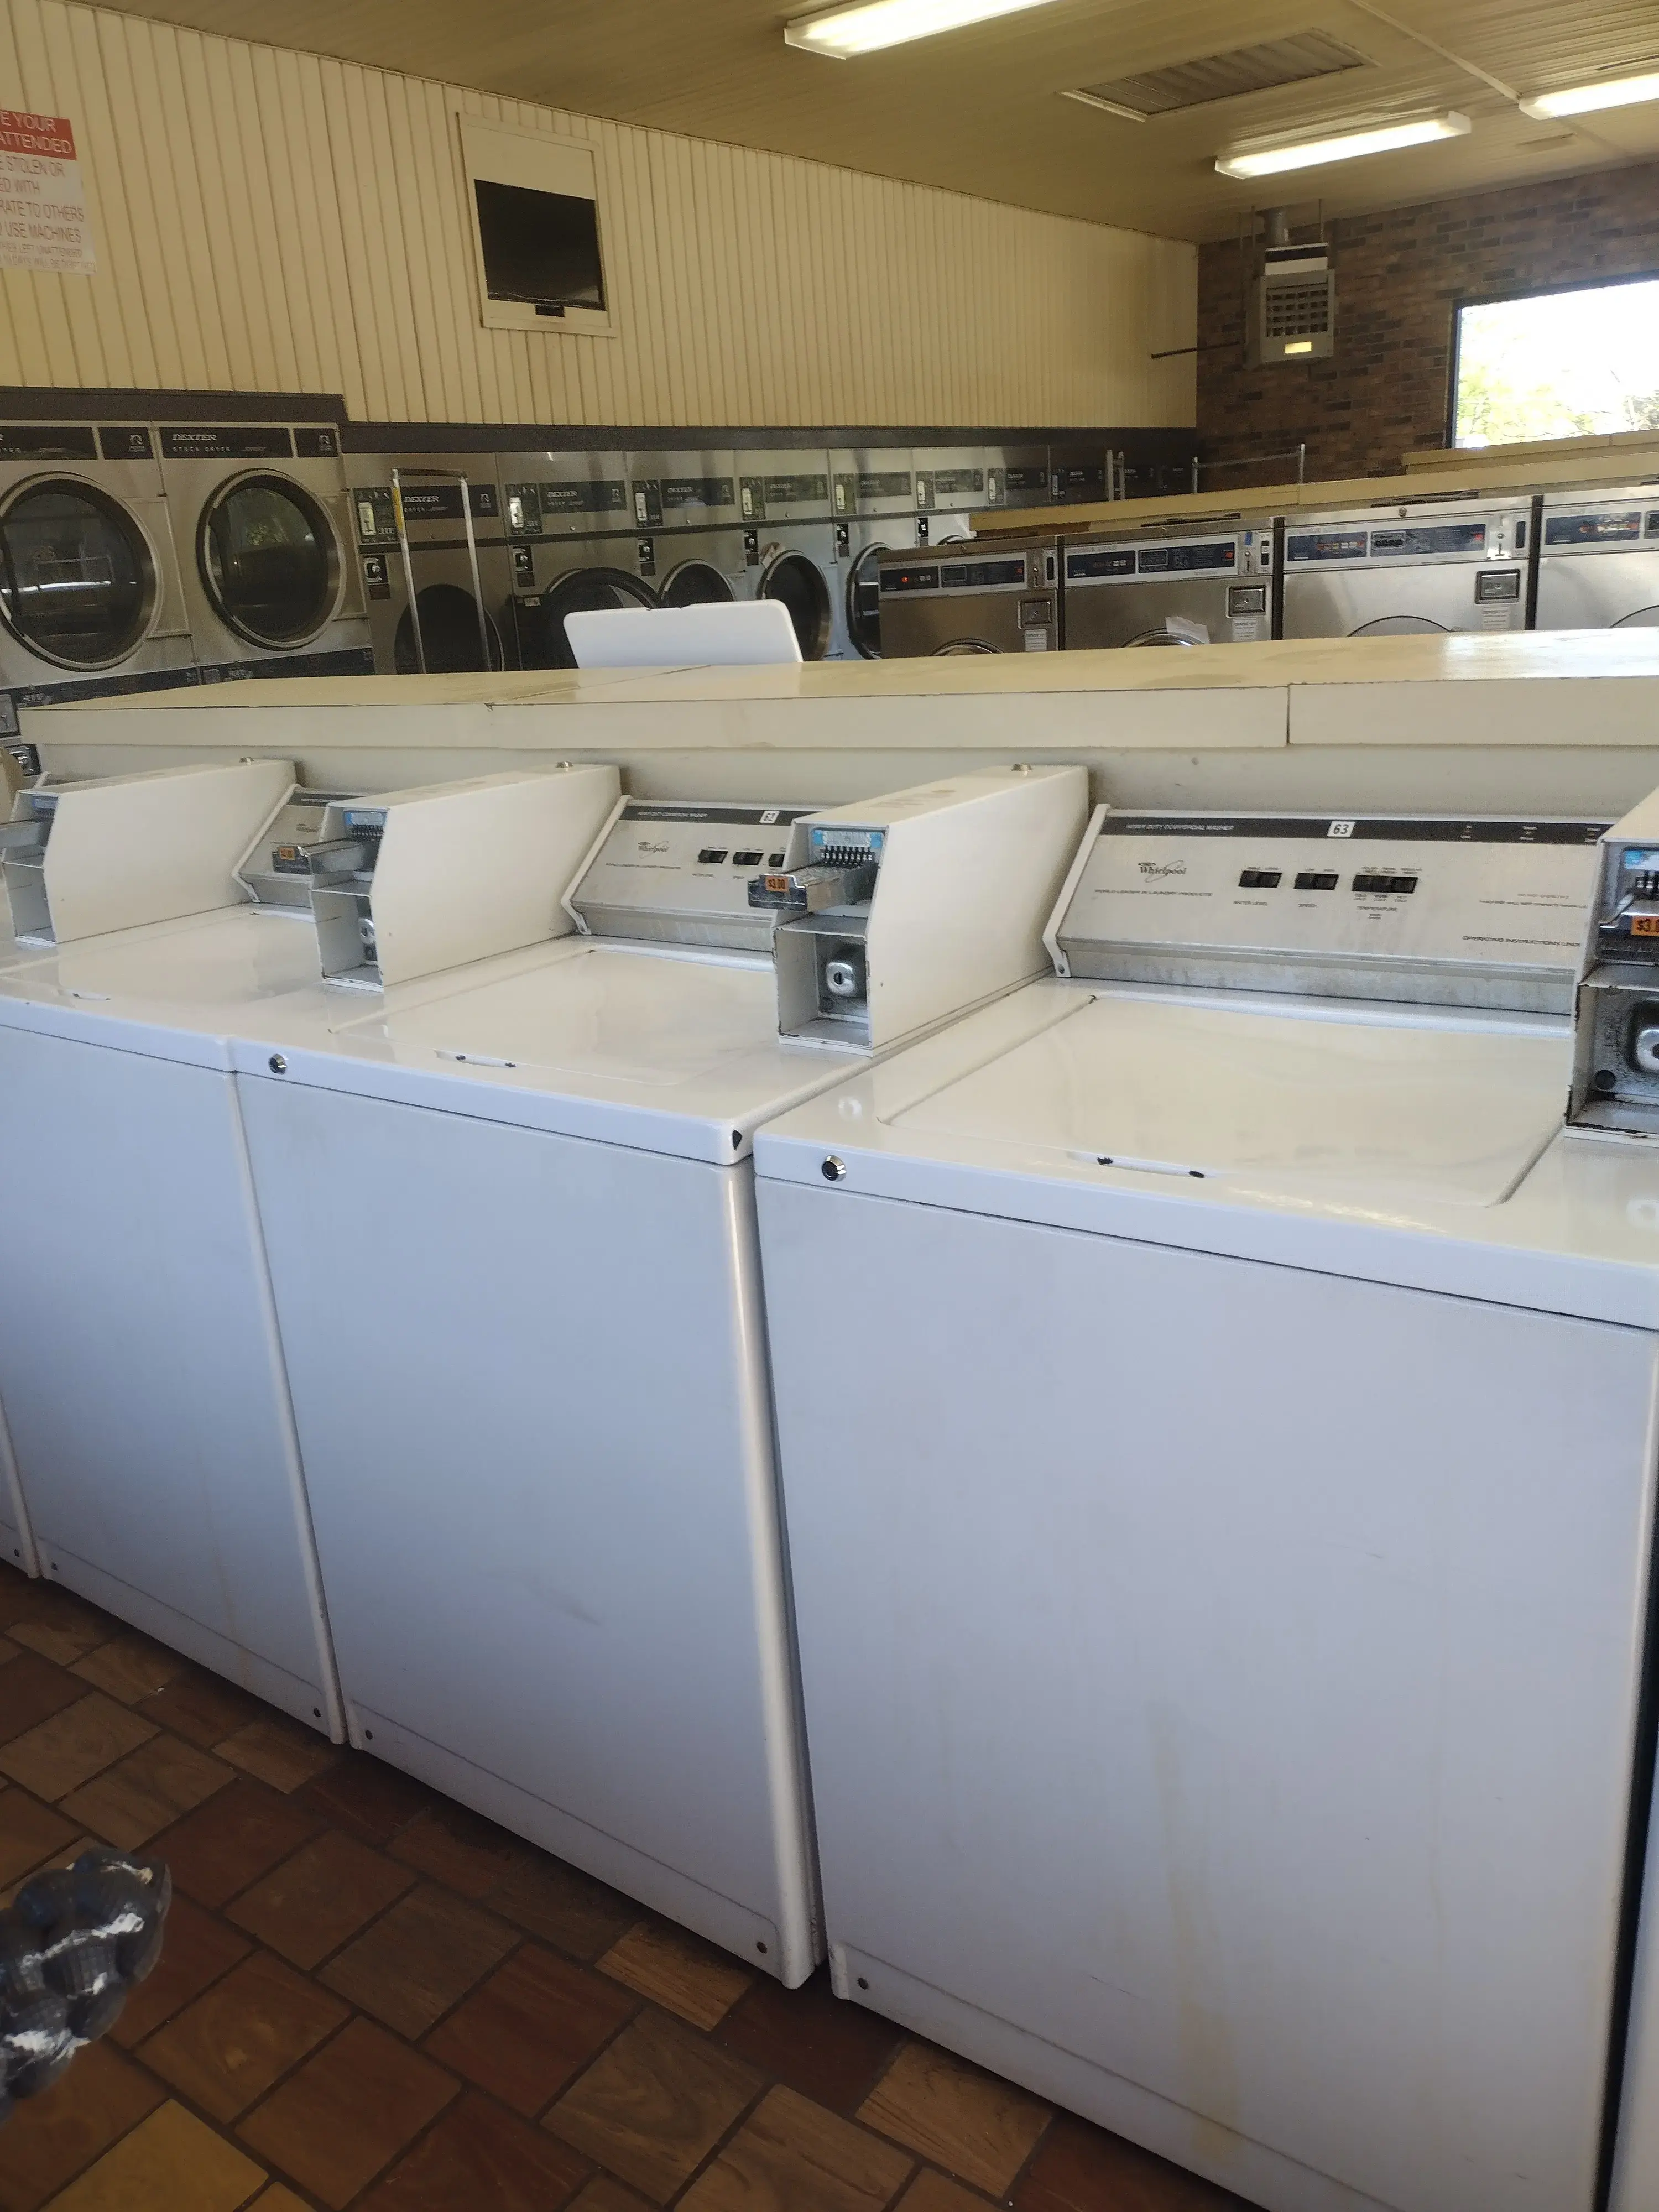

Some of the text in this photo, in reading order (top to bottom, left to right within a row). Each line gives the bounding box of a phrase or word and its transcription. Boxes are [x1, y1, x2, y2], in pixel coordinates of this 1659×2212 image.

[15, 113, 57, 133] YOUR
[6, 155, 66, 177] STOLEN OR
[14, 179, 40, 195] WITH
[26, 202, 40, 218] TO
[43, 204, 85, 223] OTHERS
[4, 219, 82, 243] USE MACHINES
[1333, 823, 1349, 834] 63
[1138, 863, 1188, 879] Whirlpool
